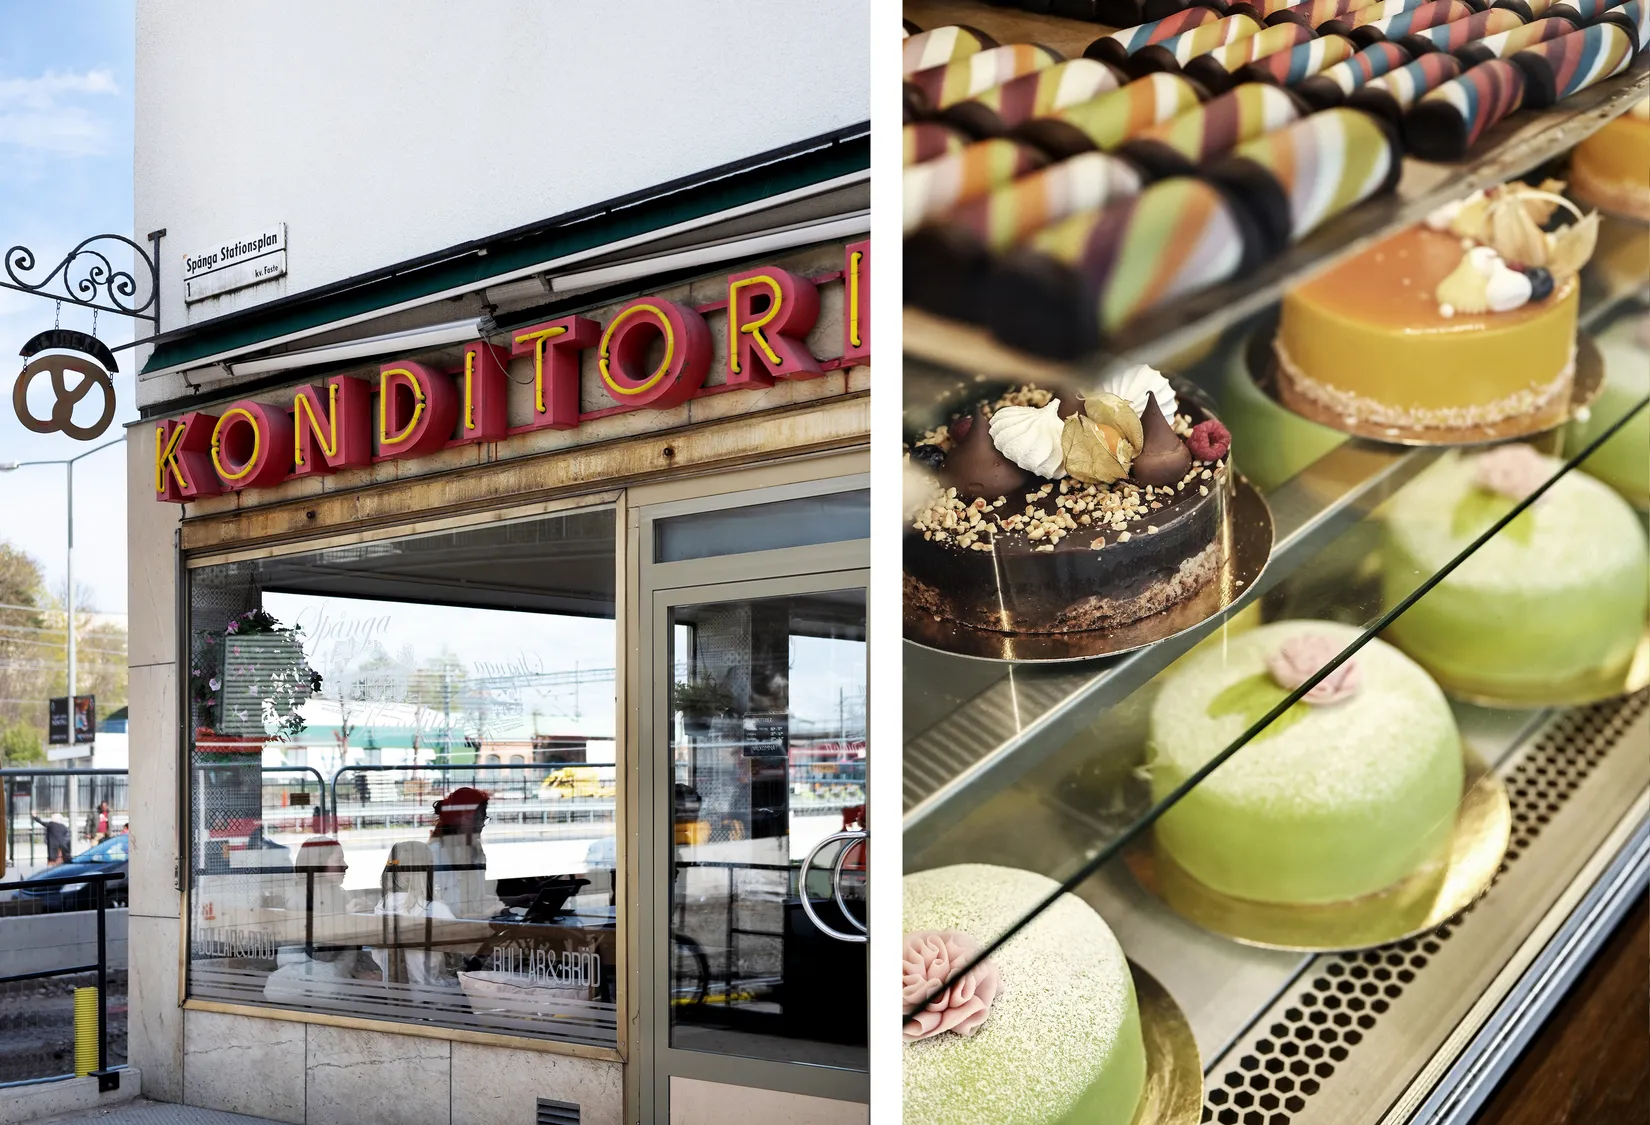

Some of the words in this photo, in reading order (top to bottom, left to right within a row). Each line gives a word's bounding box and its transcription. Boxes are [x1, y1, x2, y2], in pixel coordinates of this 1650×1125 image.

[186, 255, 218, 274] Spånga
[220, 233, 278, 261] Stationsplan
[254, 269, 264, 278] kv.
[264, 264, 279, 275] Faste
[186, 282, 192, 297] 1
[155, 240, 870, 503] KONDITORI
[293, 598, 392, 658] Spånga
[494, 946, 601, 988] BULLAR&BRÖD
